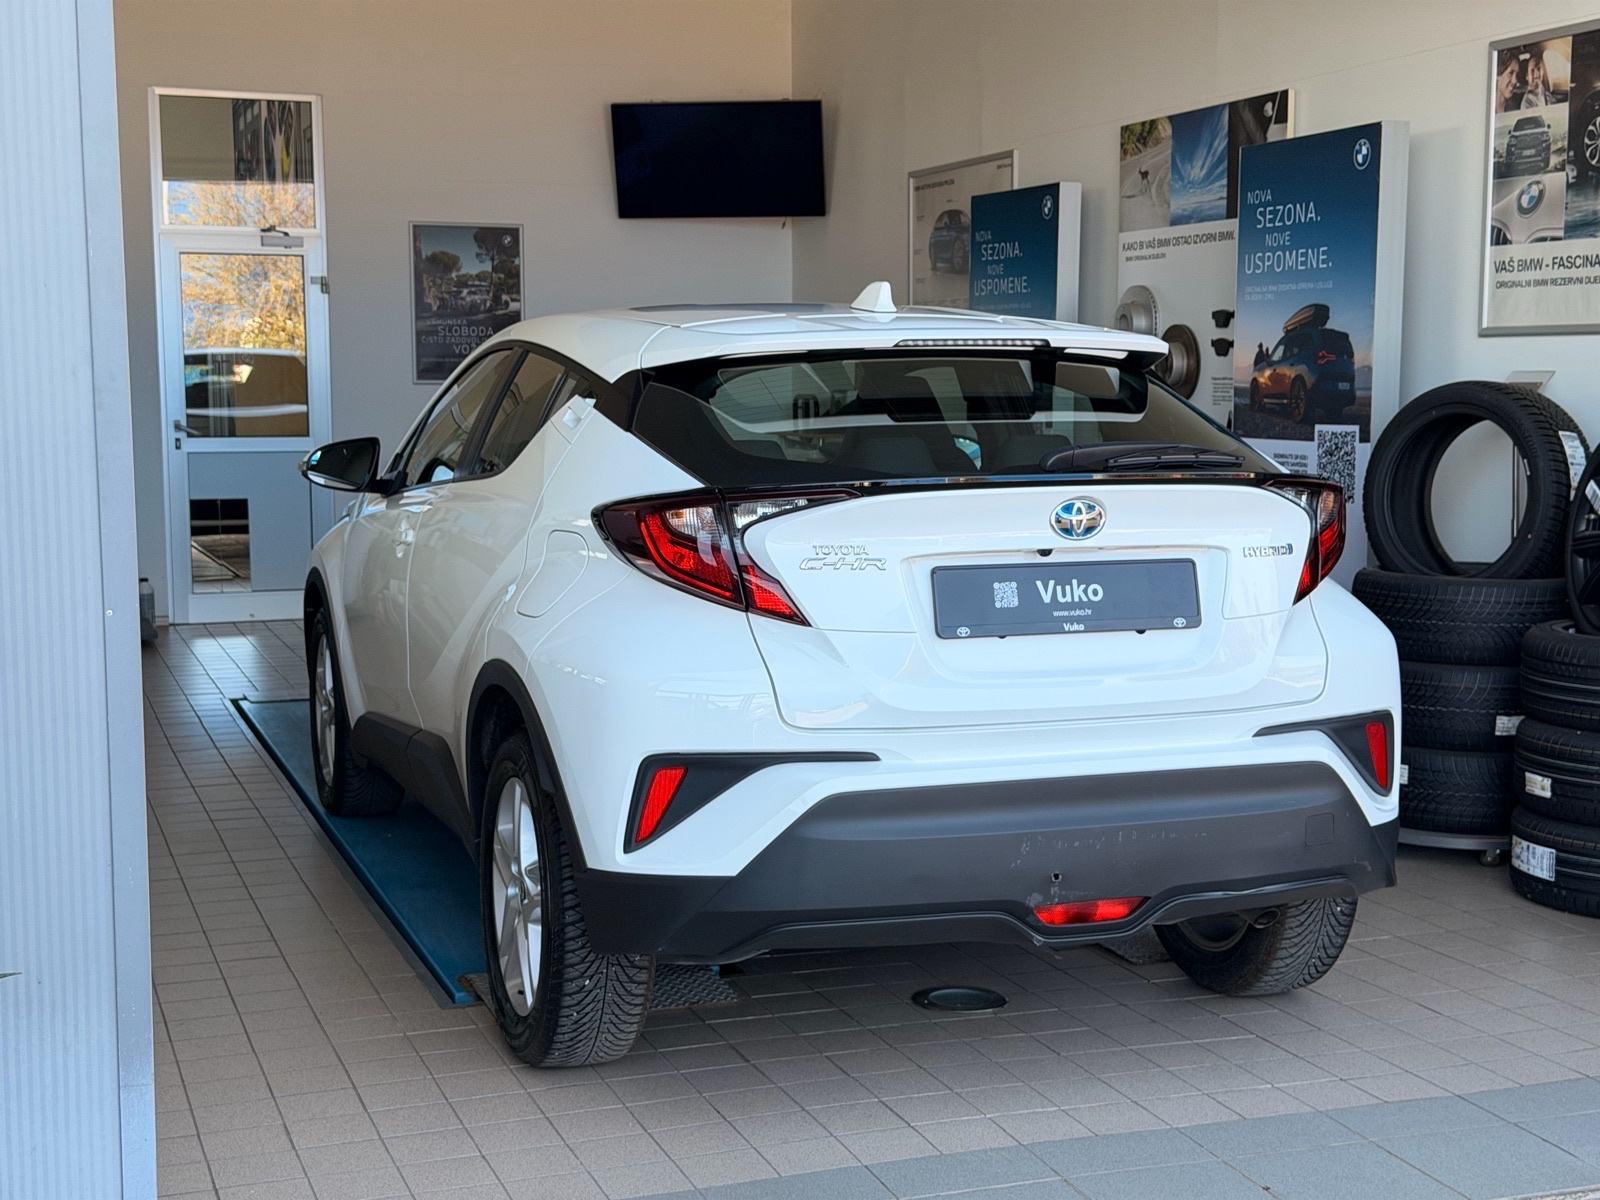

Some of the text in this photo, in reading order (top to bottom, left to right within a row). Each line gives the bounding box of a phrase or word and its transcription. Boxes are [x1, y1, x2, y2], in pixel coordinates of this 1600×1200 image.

[1247, 189, 1273, 205] NOVA
[1256, 201, 1321, 229] SEZONA.
[975, 230, 993, 242] NOVA
[1145, 236, 1156, 250] VAŠ
[1157, 237, 1171, 249] BMW
[1172, 234, 1192, 247] OSTAO
[1192, 232, 1217, 245] IZVORNI
[1265, 231, 1291, 247] NOVE
[981, 241, 1023, 261] SEZONA.
[1245, 246, 1332, 274] USPOMENE.
[1494, 256, 1515, 274] VAŠ
[1516, 257, 1544, 272] BMW
[1552, 253, 1600, 271] FASCINA
[987, 263, 1004, 275] NOVE
[974, 276, 1031, 296] USPOMENE.
[1495, 279, 1532, 290] ORIGINALNI
[1532, 279, 1549, 288] BMW
[1549, 276, 1584, 287] REZERVNI
[438, 326, 494, 336] SLOBODA
[812, 544, 869, 556] TOYOTA
[1242, 544, 1289, 558] HYBRID
[799, 557, 887, 571] C-HR
[1035, 578, 1104, 604] Vuko
[1052, 608, 1092, 617] www.vuko.hr
[1063, 621, 1085, 632] Vuko
